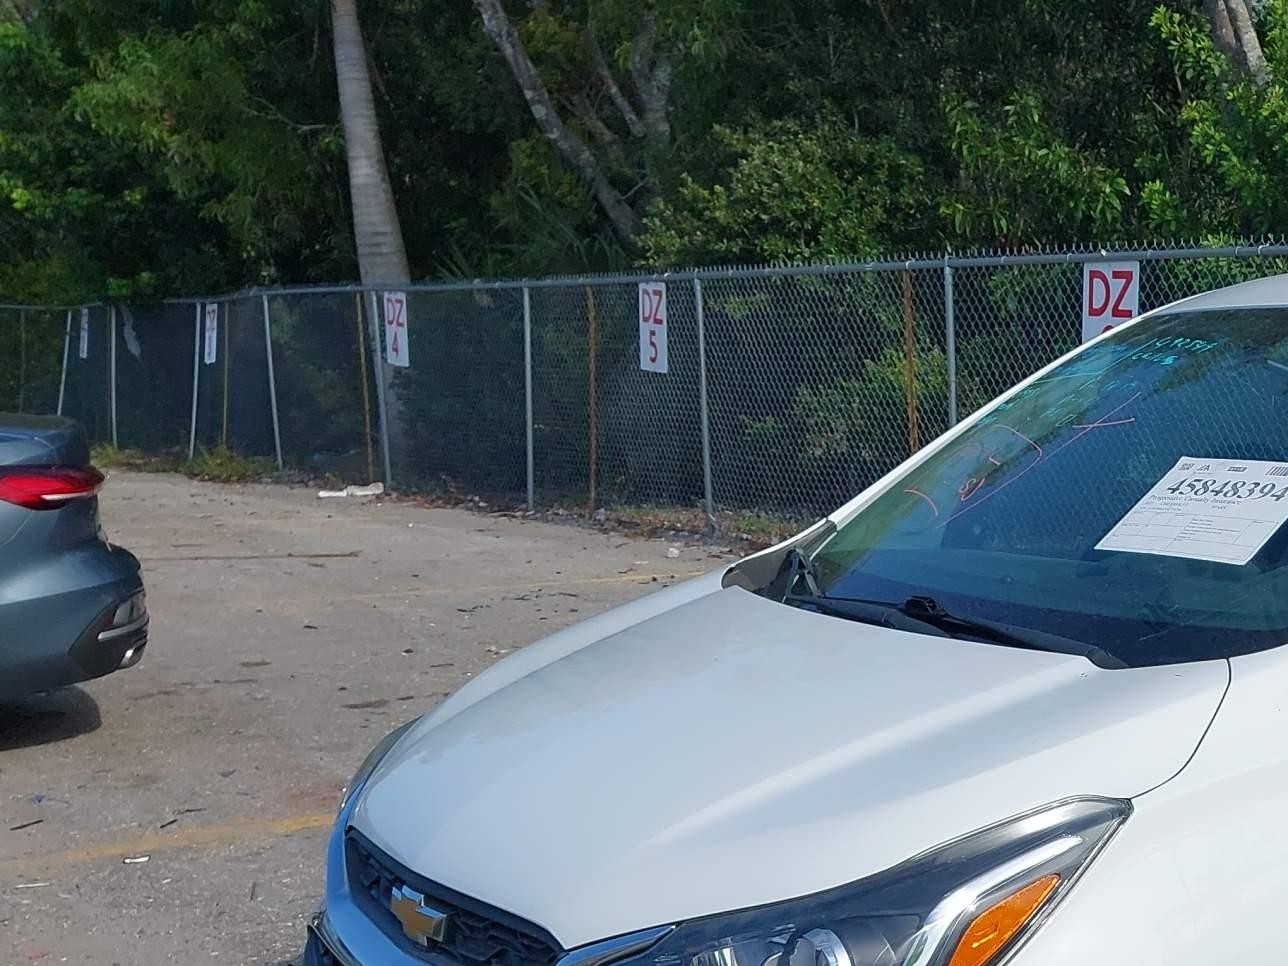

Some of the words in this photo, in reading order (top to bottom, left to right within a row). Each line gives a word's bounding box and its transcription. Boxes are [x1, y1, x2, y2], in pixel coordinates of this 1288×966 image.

[641, 287, 664, 326] DZ
[1087, 269, 1134, 318] DZ
[386, 297, 405, 328] DZ
[391, 330, 400, 359] 4
[648, 329, 659, 364] 5
